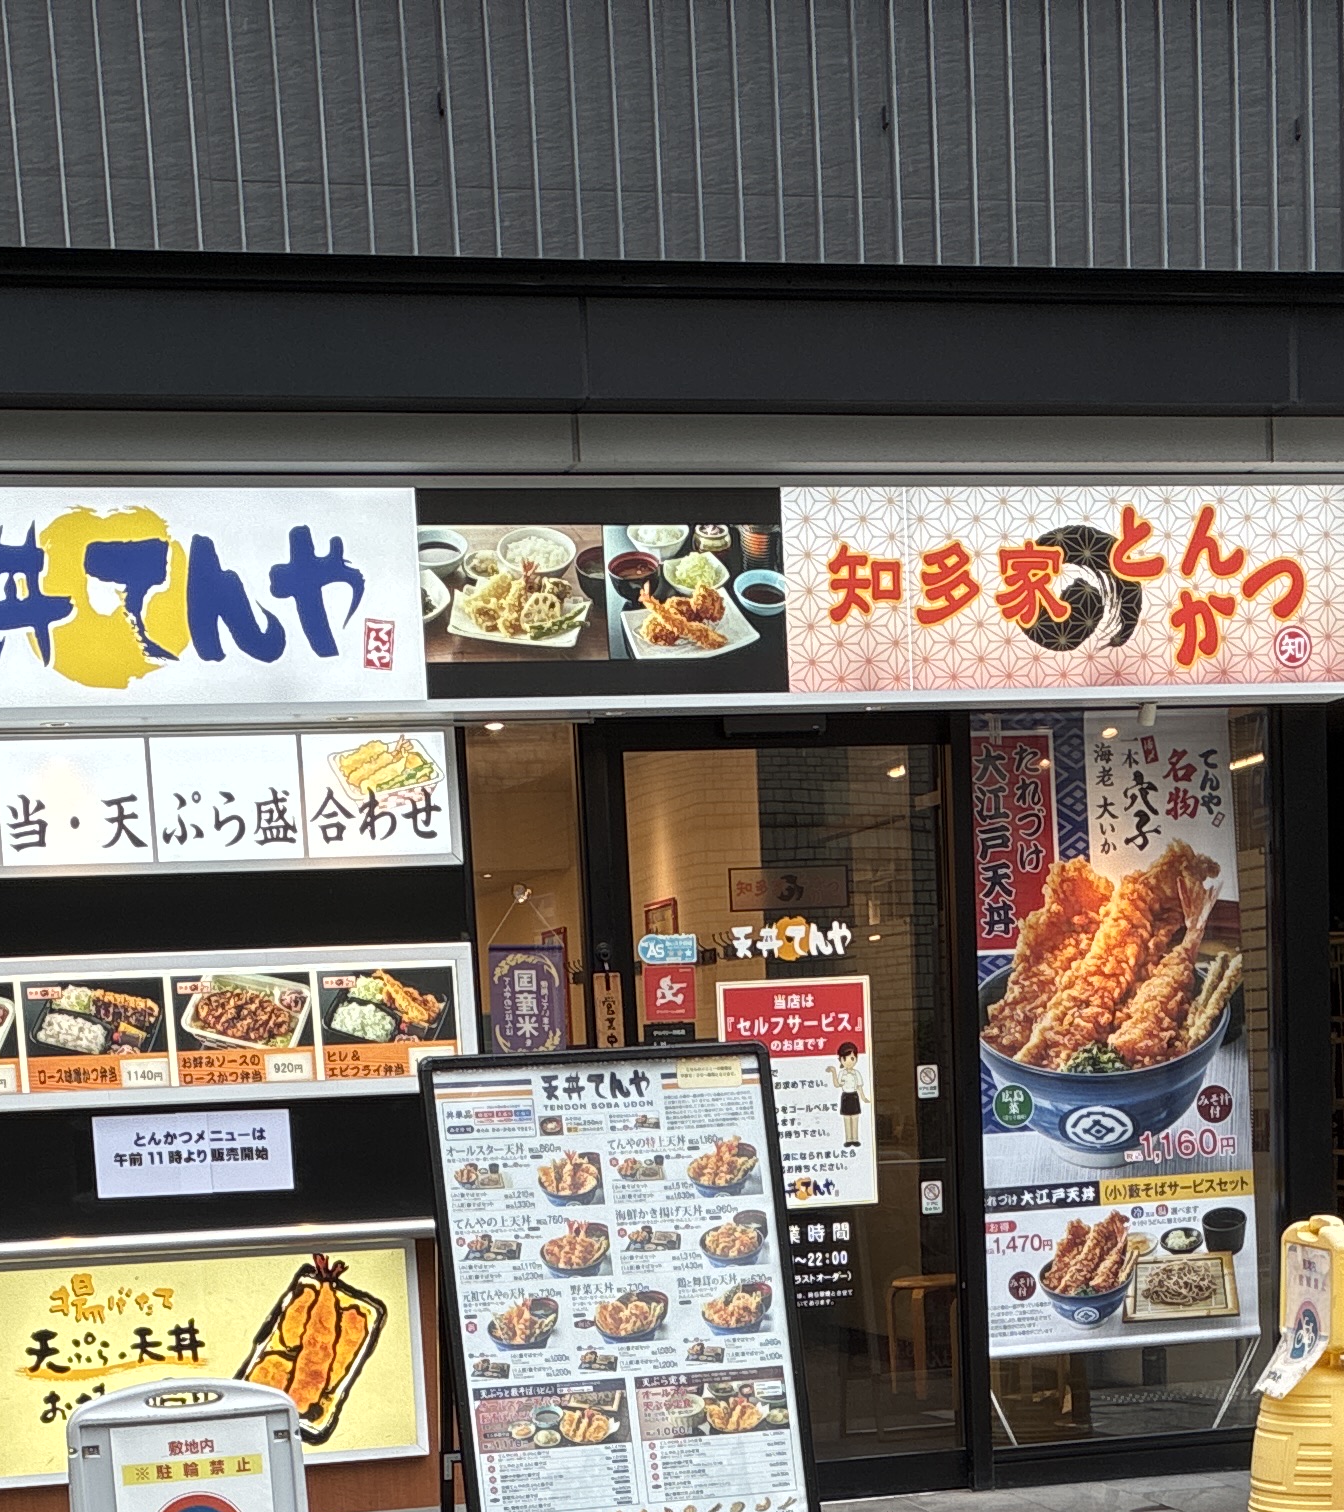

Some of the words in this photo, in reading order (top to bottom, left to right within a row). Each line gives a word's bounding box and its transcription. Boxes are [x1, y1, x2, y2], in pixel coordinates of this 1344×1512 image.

[827, 540, 1073, 627] 知多家
[1093, 743, 1114, 787] 海老
[1163, 748, 1201, 821] 名物
[1198, 749, 1222, 815] てんや
[1013, 744, 1046, 873] たれづけ
[973, 743, 1017, 938] 大江戸天丼
[731, 920, 852, 959] 天丼てんや
[773, 993, 815, 1010] 当店は
[726, 1012, 863, 1037] 『セルフサービス』
[770, 1038, 827, 1052] のお店です
[182, 1053, 261, 1069] お好みソースの
[274, 1062, 304, 1074] 920円
[328, 1063, 405, 1078] エビフライ弁当
[126, 1070, 163, 1082] 1140円
[182, 1070, 263, 1084] ロースかつ弁当
[541, 1069, 651, 1101] 天丼てんや
[543, 1103, 587, 1111] TENDON
[623, 1100, 654, 1108] UDON
[133, 1127, 267, 1147] とんかつメニューは
[446, 1143, 524, 1157] オールスター天丼
[454, 1215, 532, 1230] てんやの上天丼
[49, 1273, 175, 1324] 揚げたて
[168, 1437, 215, 1455] 敷地内
